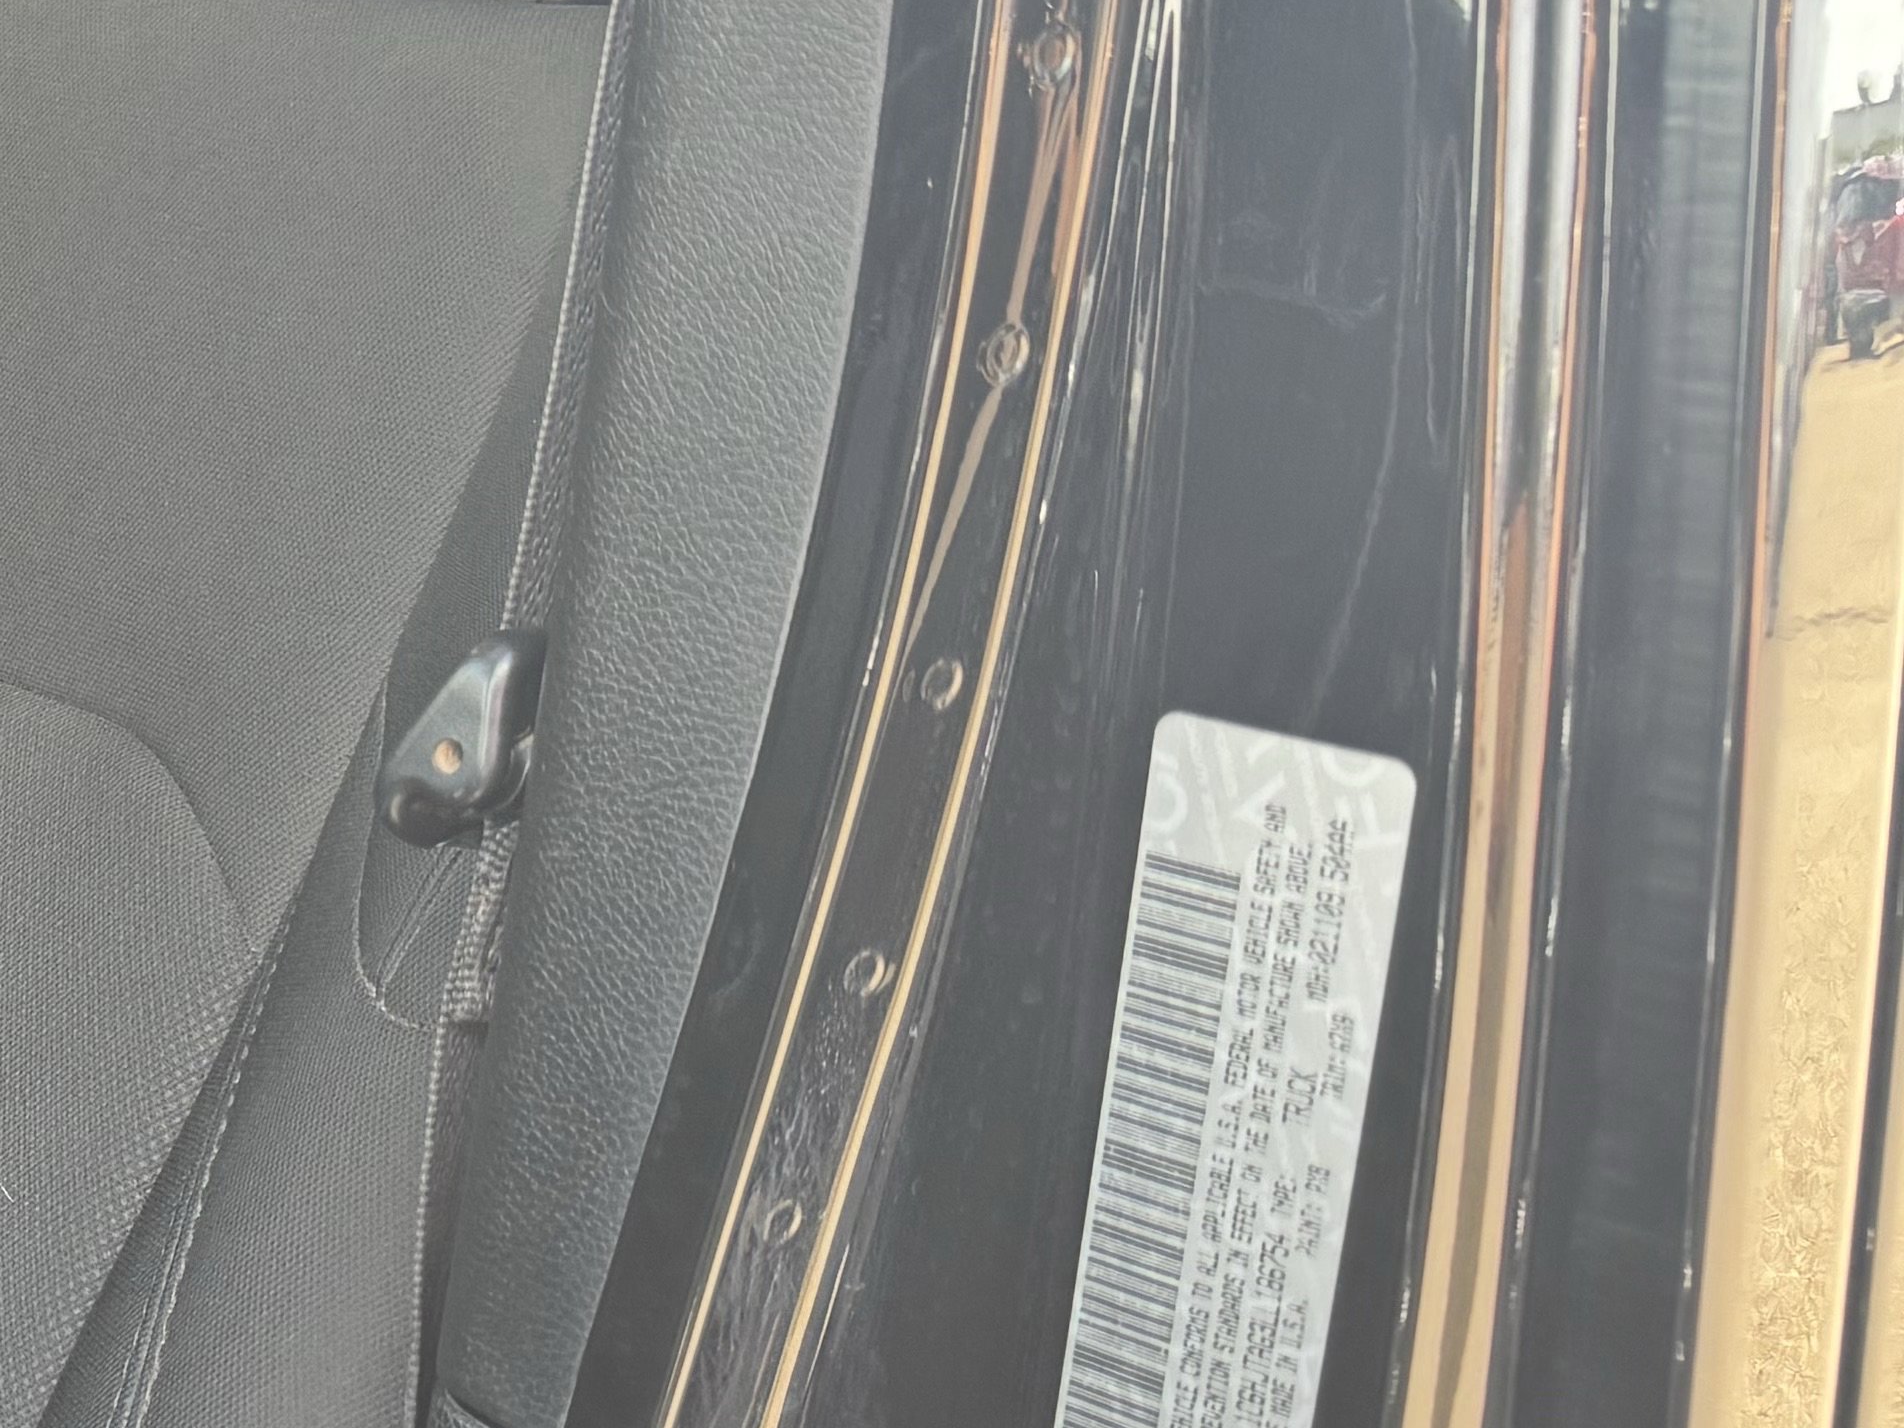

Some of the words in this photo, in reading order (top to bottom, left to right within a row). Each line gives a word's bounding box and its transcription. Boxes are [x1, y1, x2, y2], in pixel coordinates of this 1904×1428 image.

[1262, 802, 1287, 833] AND
[1253, 837, 1282, 896] SAFETY
[1283, 837, 1314, 894] ABOVE.
[1242, 900, 1273, 967] VEHICLE
[1275, 898, 1304, 948] SHOWN
[1234, 971, 1262, 1020] MOTOR
[1259, 952, 1297, 1054] MANUFACTURE
[1223, 1023, 1254, 1089] FEDERAL
[1255, 1056, 1280, 1080] OF
[1248, 1083, 1276, 1124] DATE
[1281, 1064, 1319, 1130] TRUCK
[1243, 1127, 1269, 1157] THE
[1200, 1152, 1235, 1243] APPLICABLE
[1239, 1162, 1263, 1184] ON
[1229, 1186, 1260, 1245] EFFECT
[1195, 1246, 1219, 1277] ALL
[1226, 1247, 1249, 1268] IN
[1191, 1280, 1213, 1301] TO
[1212, 1271, 1246, 1355] STANDARDS
[1179, 1304, 1210, 1379] CONFORMS
[1275, 1352, 1299, 1374] IN
[1268, 1377, 1295, 1419] MADE
